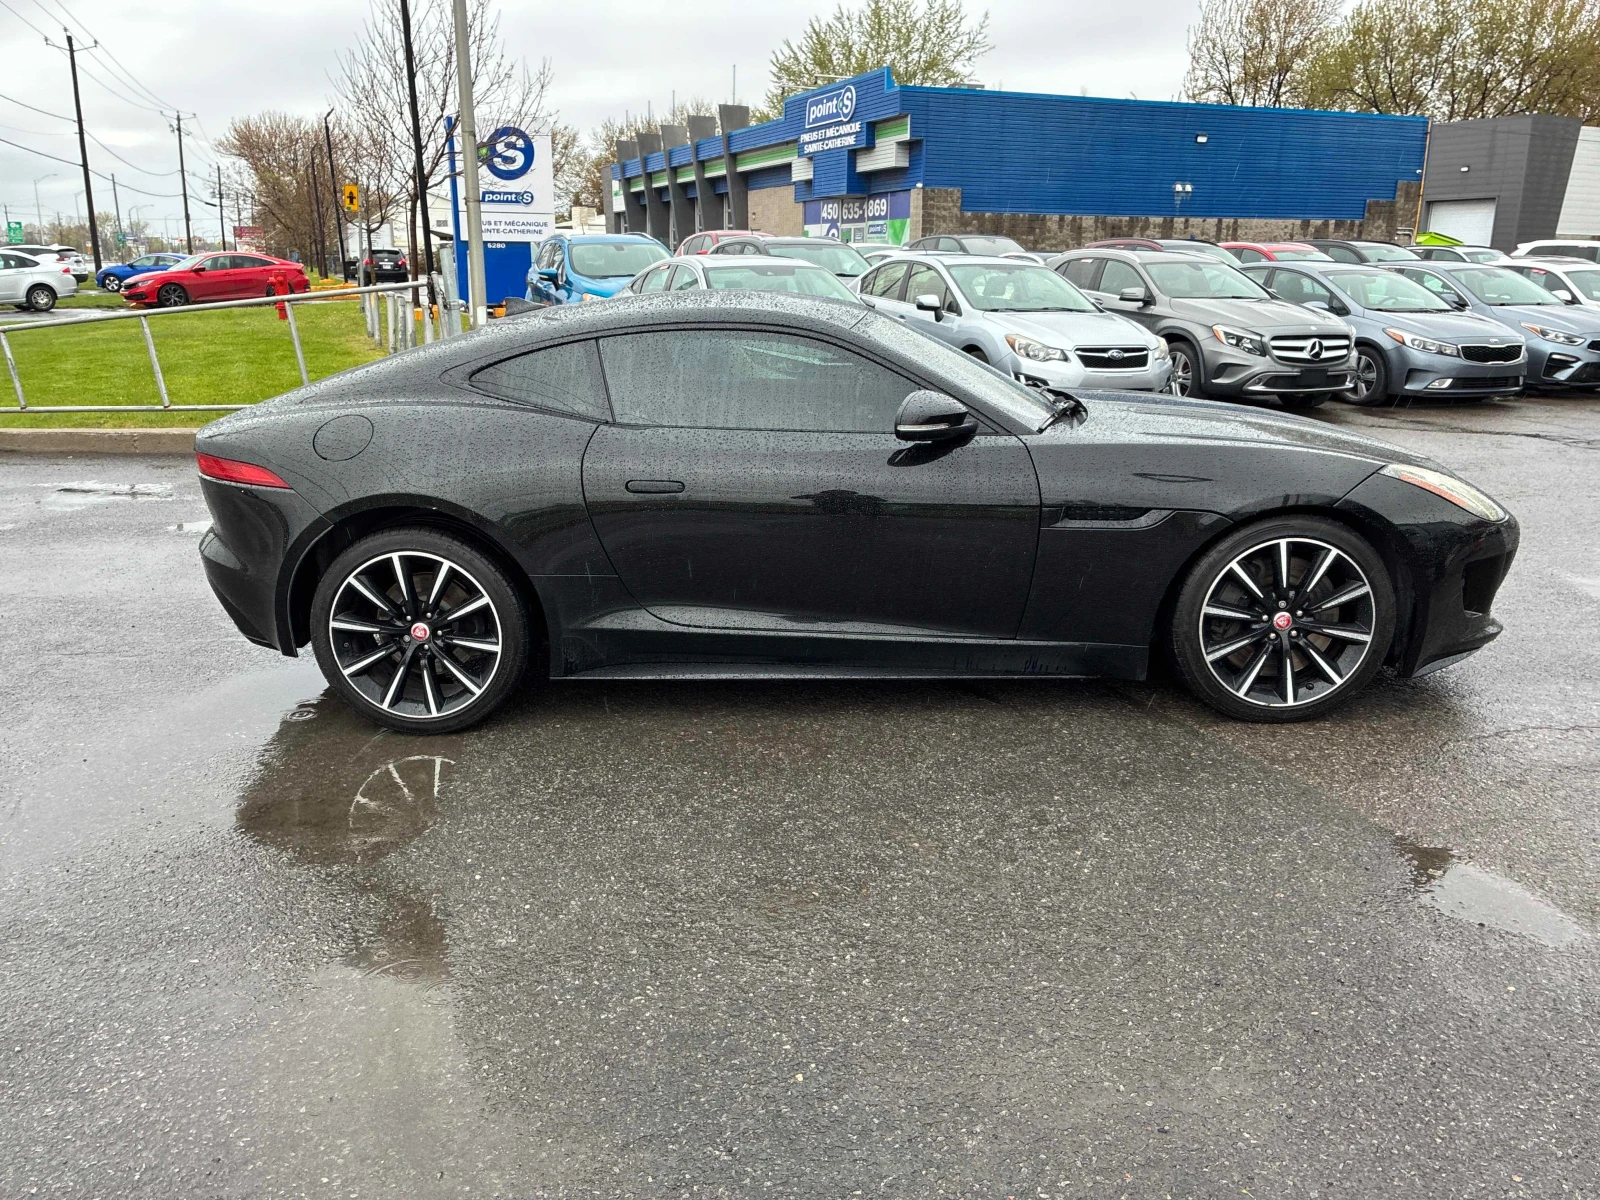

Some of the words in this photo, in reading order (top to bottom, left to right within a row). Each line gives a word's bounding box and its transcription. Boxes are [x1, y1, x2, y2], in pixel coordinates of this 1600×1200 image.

[810, 97, 837, 122] point
[843, 91, 852, 114] S
[801, 131, 819, 143] PNEUS
[819, 129, 826, 140] ET
[826, 121, 861, 137] MÉCANIQUE
[804, 134, 856, 154] SAINTE-CATHERINE
[485, 193, 516, 202] point
[522, 193, 532, 203] S
[822, 203, 839, 219] 450
[842, 199, 887, 219] 635-1869
